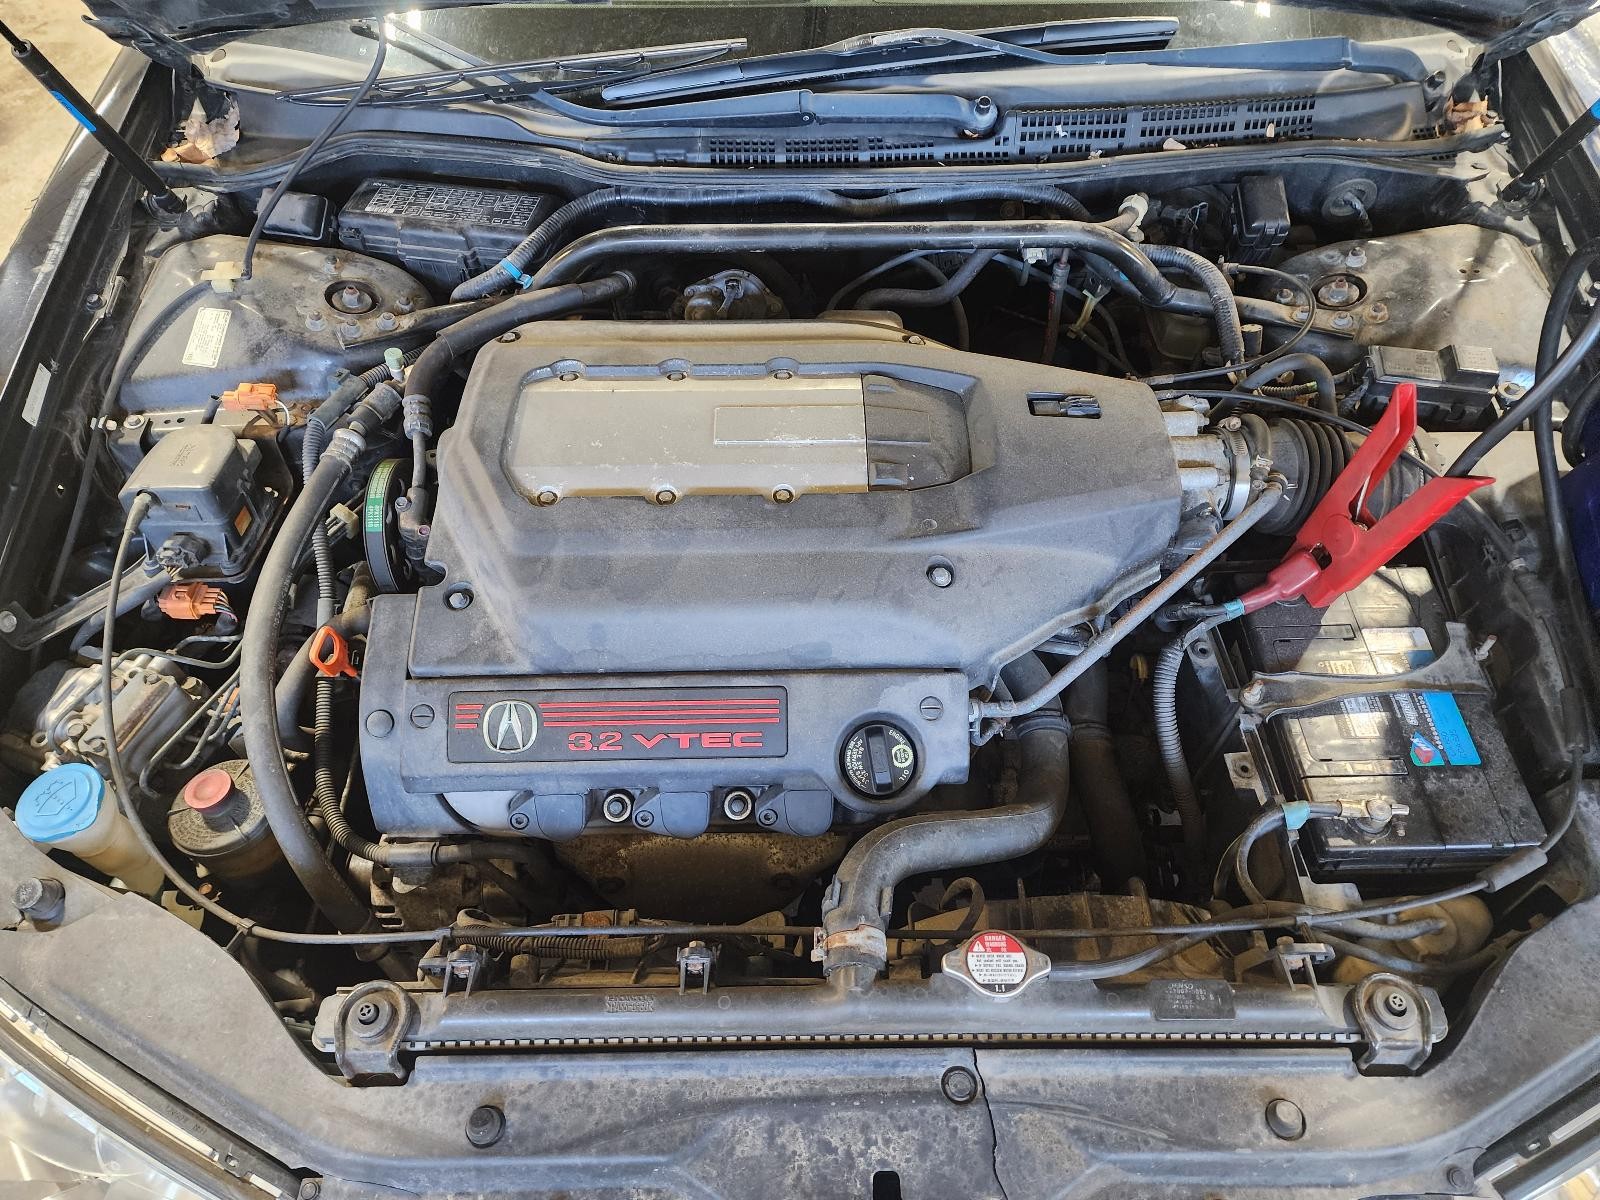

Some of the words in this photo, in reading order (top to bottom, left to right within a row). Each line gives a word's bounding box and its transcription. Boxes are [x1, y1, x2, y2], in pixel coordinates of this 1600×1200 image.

[568, 731, 623, 751] 3.2
[631, 731, 763, 750] VTEC
[888, 729, 906, 744] ENGINE
[898, 769, 910, 781] OIL
[994, 984, 1006, 993] 1.1
